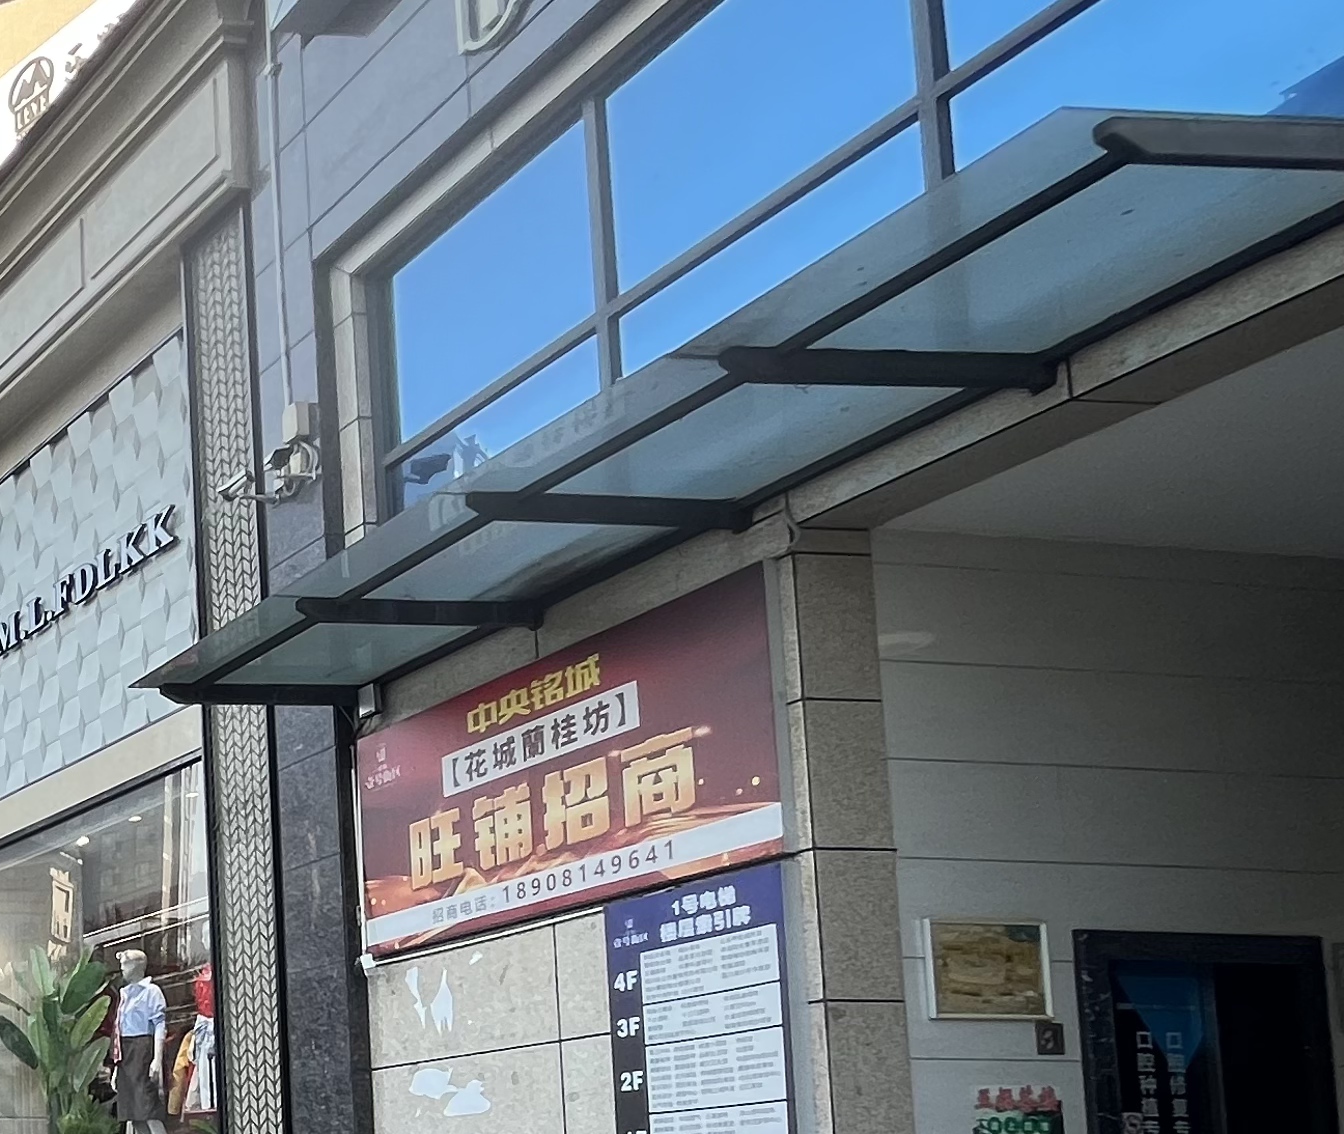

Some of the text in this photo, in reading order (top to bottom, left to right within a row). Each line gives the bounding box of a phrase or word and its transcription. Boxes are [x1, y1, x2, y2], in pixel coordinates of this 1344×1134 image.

[467, 653, 600, 734] 中央铭城
[409, 727, 696, 890] 旺铺招商
[503, 840, 675, 903] 18908149641
[613, 970, 639, 992] 4F
[616, 1016, 641, 1038] 3F
[620, 1070, 644, 1092] 2F
